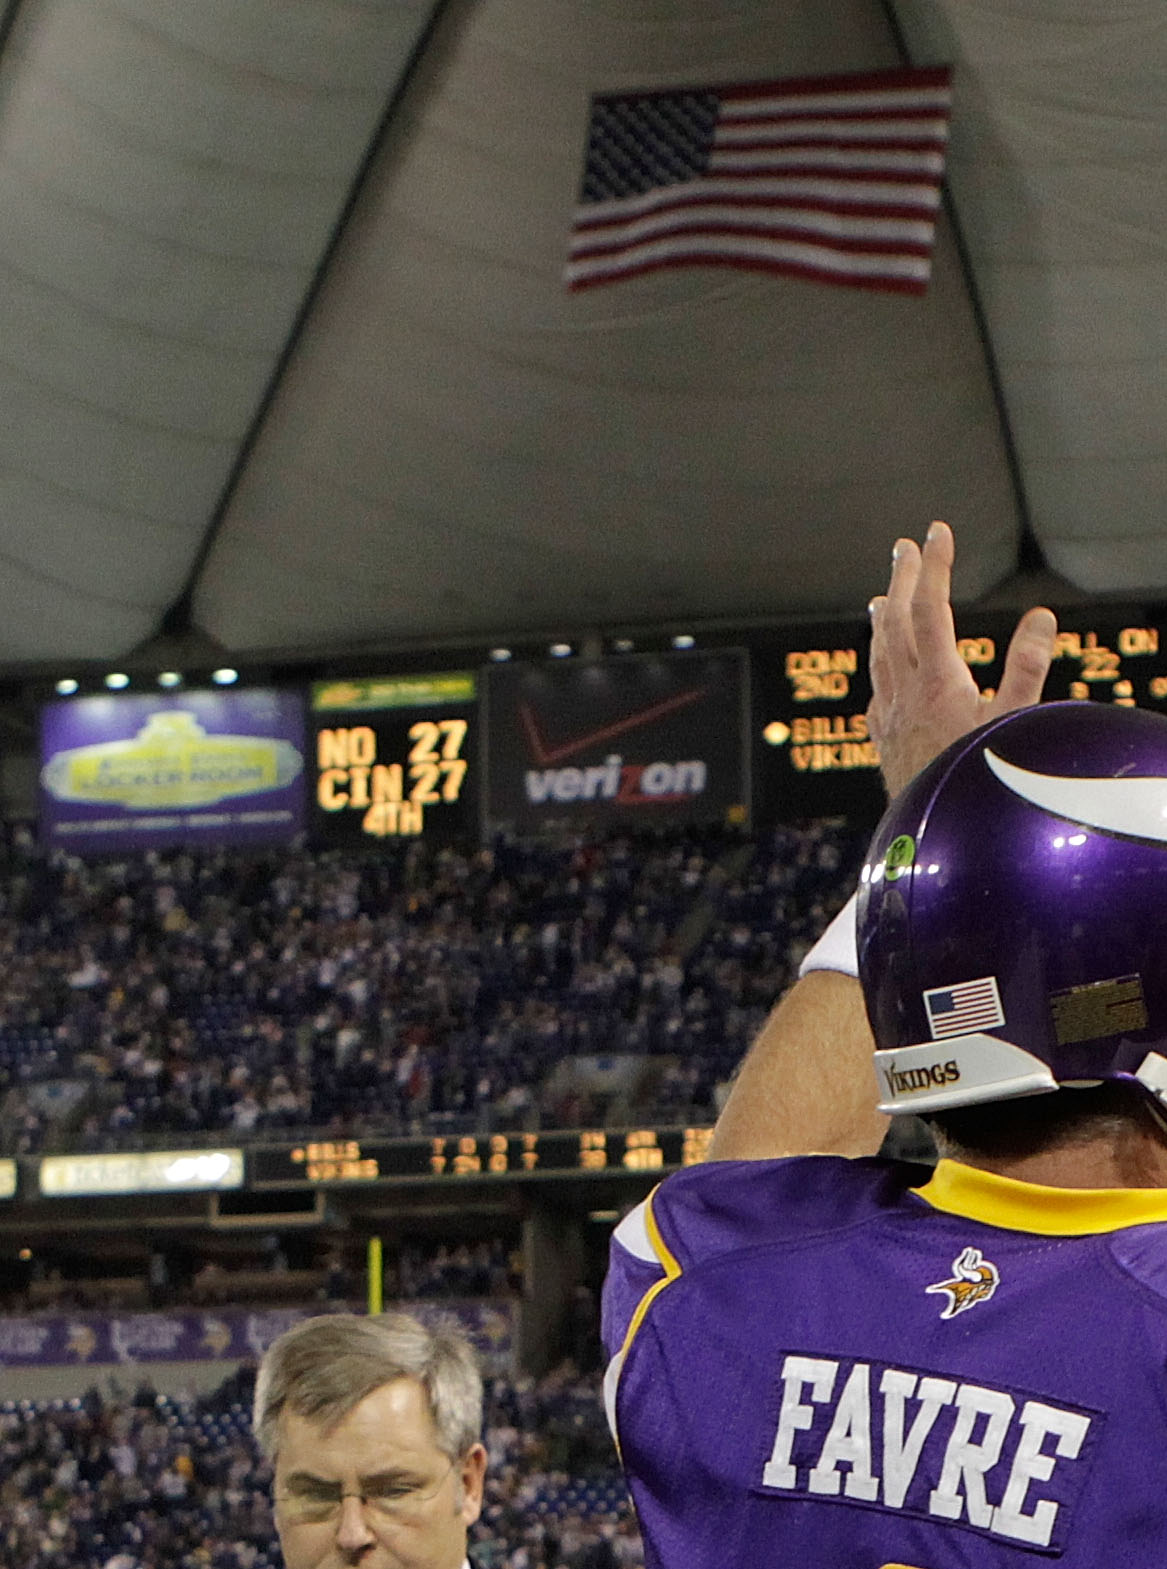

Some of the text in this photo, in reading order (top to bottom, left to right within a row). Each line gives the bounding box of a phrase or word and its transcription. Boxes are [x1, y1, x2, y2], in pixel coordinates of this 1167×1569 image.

[1119, 628, 1159, 656] ON
[786, 649, 858, 677] DOWN
[792, 673, 850, 699] 2ND
[317, 719, 468, 770] NO 27
[317, 760, 468, 812] CIN 27
[525, 754, 707, 803] verizon
[362, 801, 424, 837] 4TH
[883, 1060, 961, 1098] VIKINGS
[762, 1355, 1091, 1547] FAVRE
